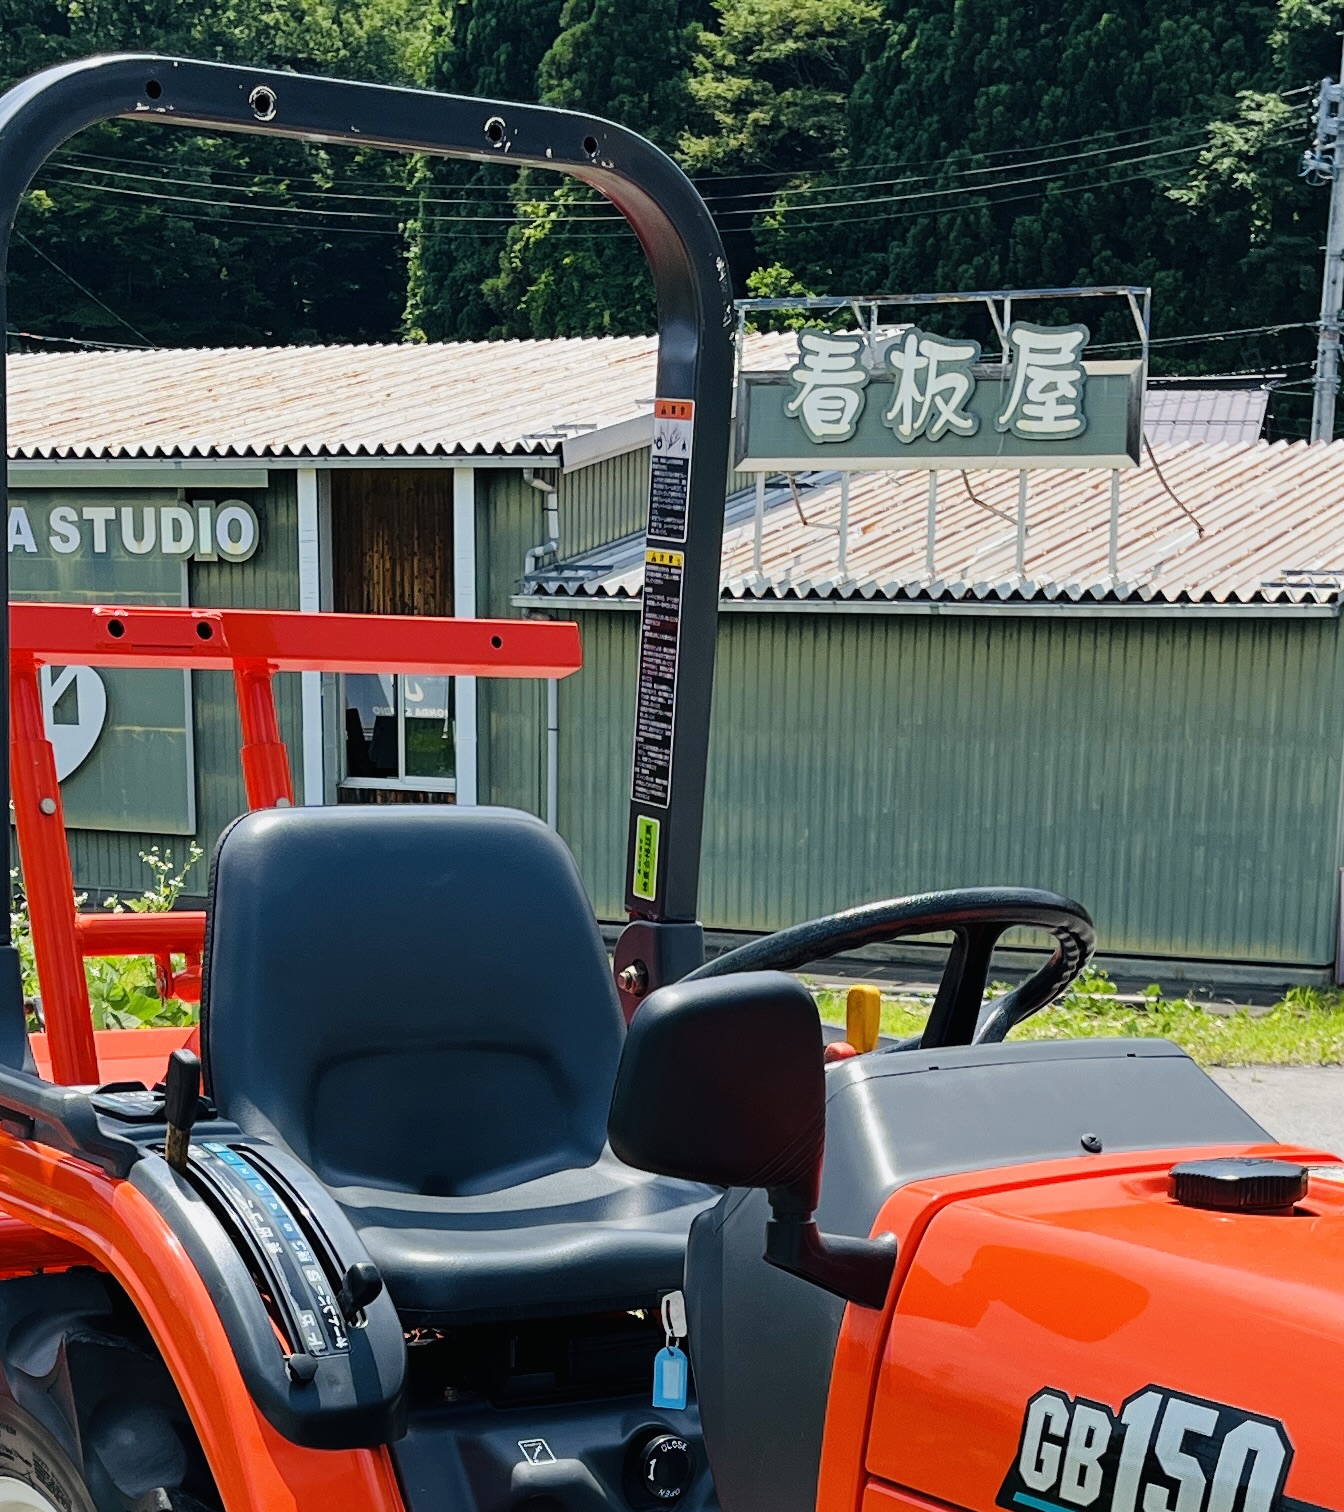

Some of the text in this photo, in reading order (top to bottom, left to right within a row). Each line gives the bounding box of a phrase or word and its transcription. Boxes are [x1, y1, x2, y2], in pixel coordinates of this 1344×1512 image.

[787, 328, 1084, 437] 看板屋
[49, 506, 255, 554] STUDIO
[660, 1439, 687, 1453] CLOSE
[658, 1487, 681, 1498] OPEN
